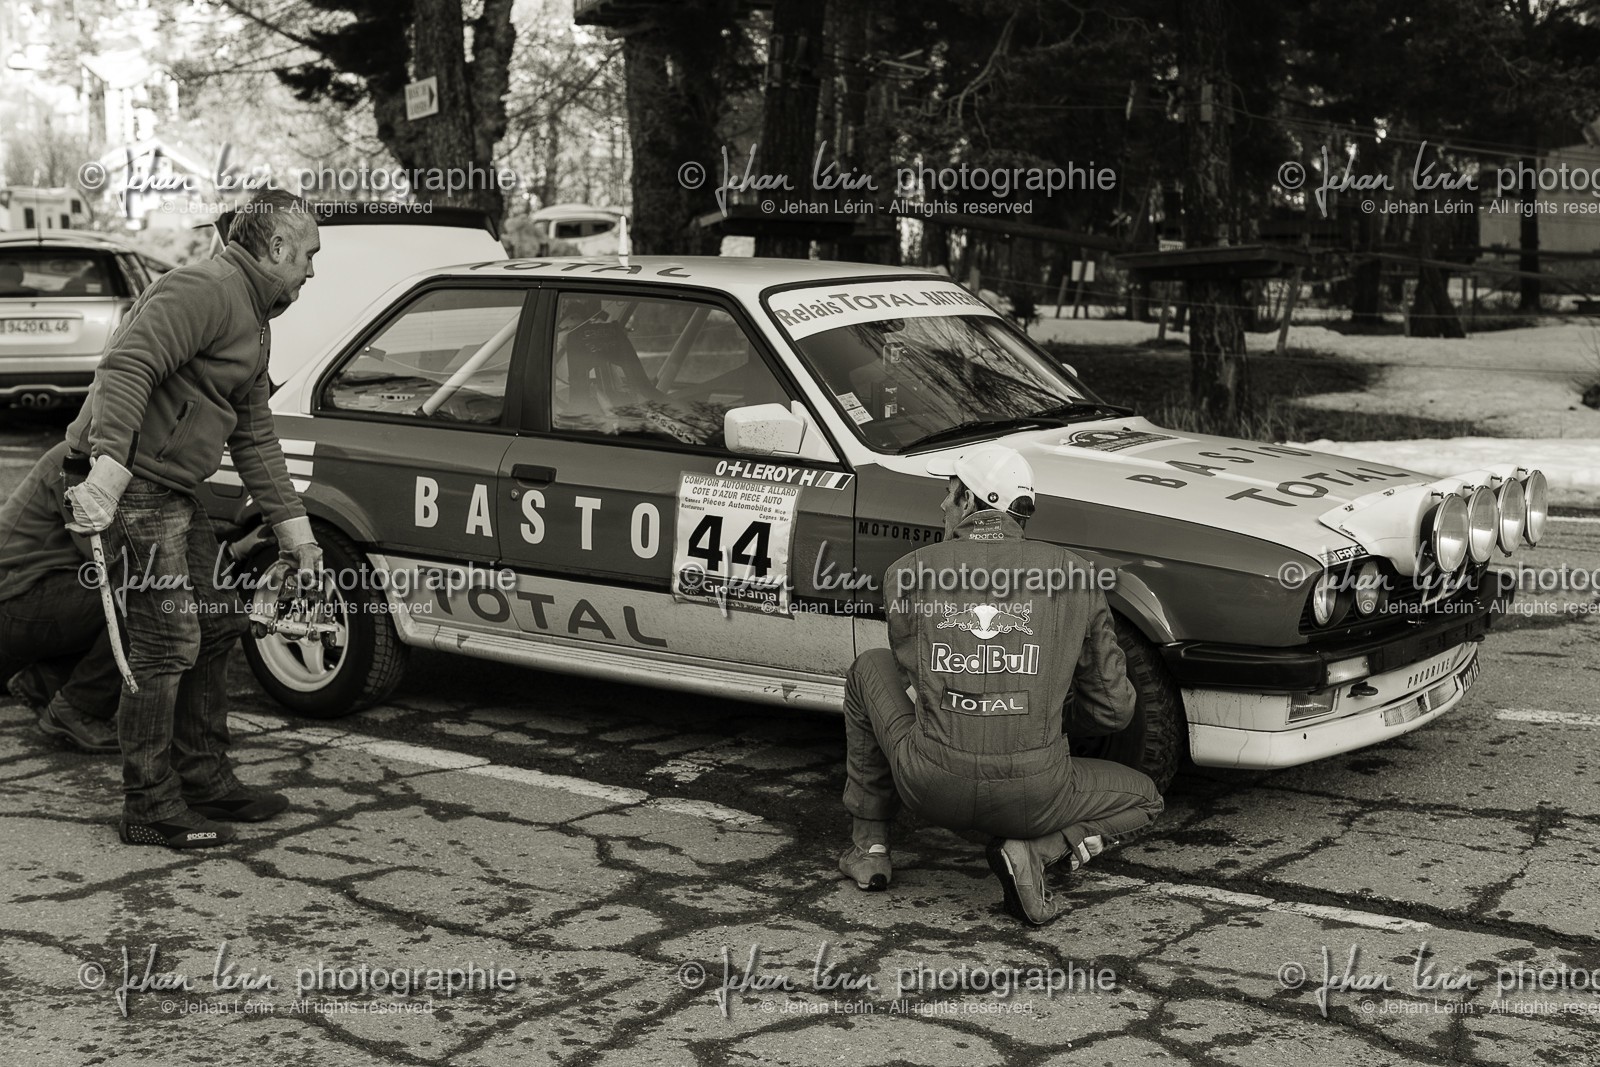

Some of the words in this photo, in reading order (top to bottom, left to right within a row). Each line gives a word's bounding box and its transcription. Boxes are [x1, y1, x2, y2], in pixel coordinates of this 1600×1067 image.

[775, 299, 843, 327] Relais
[828, 293, 928, 312] TOTAL
[1125, 446, 1312, 489] BASTO
[684, 475, 719, 488] COMPTOIR
[721, 480, 766, 493] AUTOMOBILE
[767, 485, 797, 497] ALLARD
[692, 486, 709, 496] COTE
[712, 488, 738, 500] D'AZUR
[740, 492, 761, 503] PIECE
[762, 495, 783, 506] AUTO
[1225, 467, 1410, 507] TOTAL
[414, 475, 661, 559] BASTO
[702, 497, 726, 507] Pièces
[728, 500, 772, 513] Automobiles
[687, 514, 772, 582] 44
[969, 532, 1004, 541] sparco
[417, 564, 668, 649] TOTAL
[702, 580, 777, 602] Groupama
[1407, 657, 1451, 689] PRODRIVE
[947, 691, 1024, 712] TOTAL
